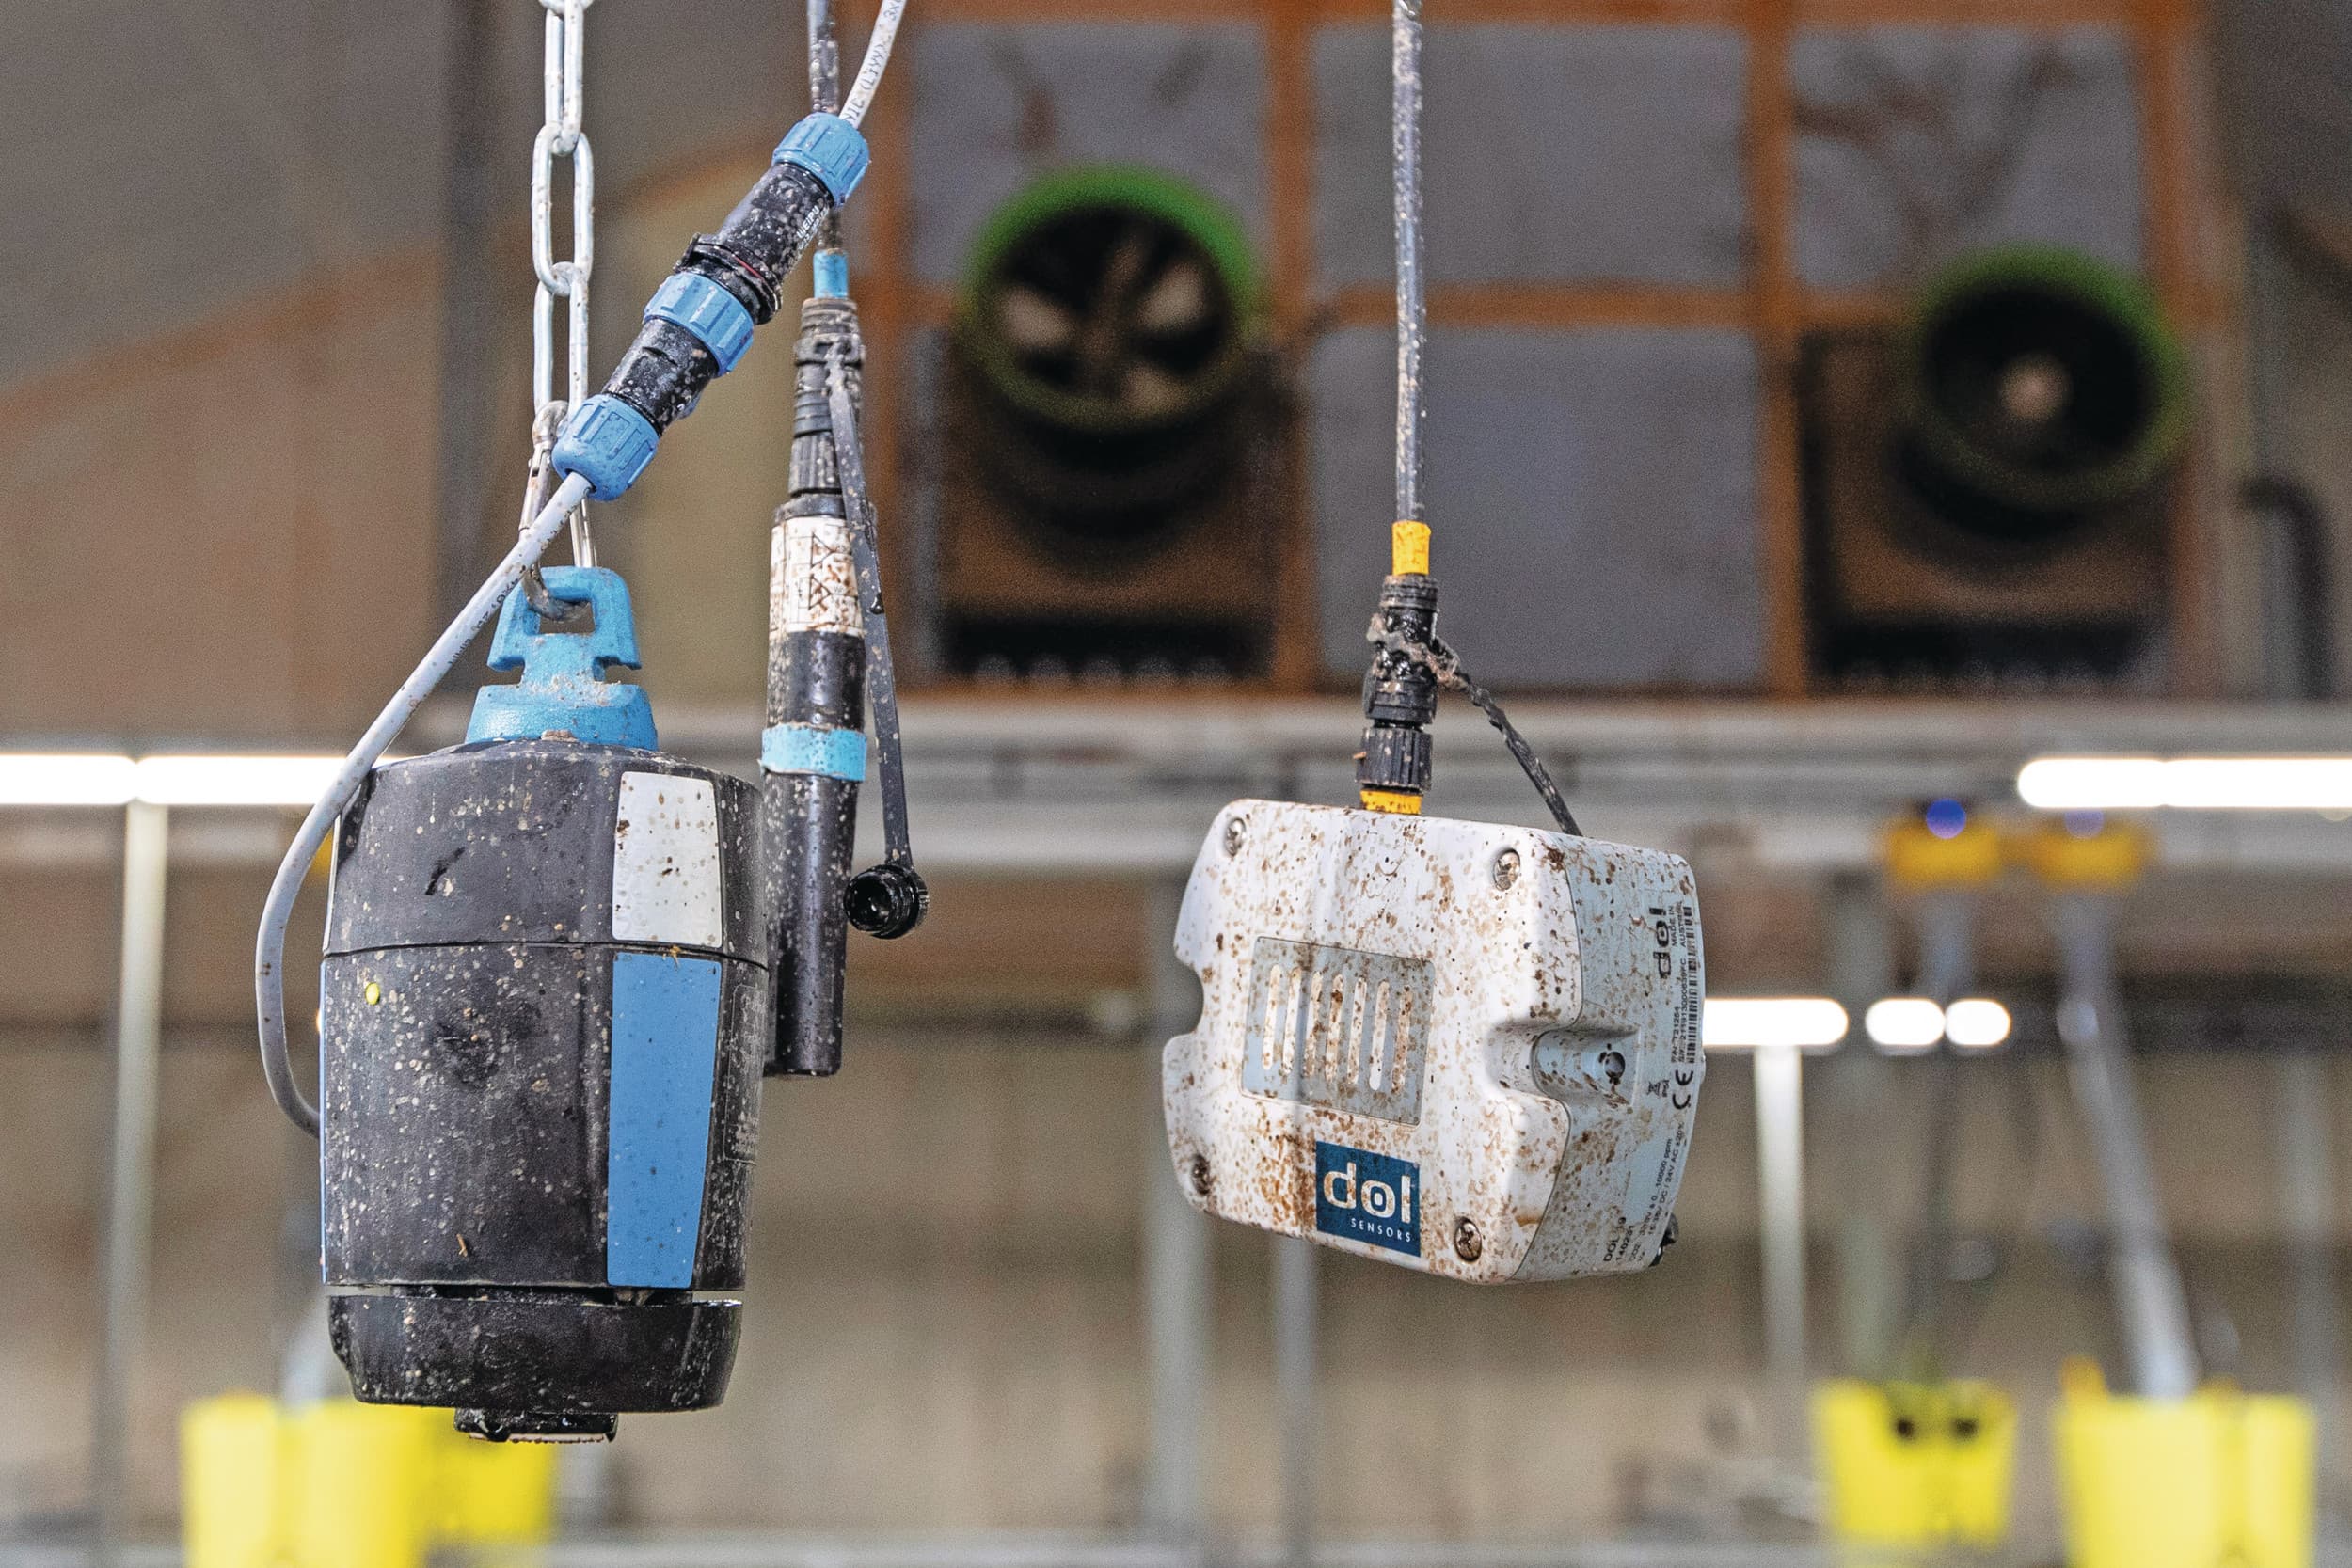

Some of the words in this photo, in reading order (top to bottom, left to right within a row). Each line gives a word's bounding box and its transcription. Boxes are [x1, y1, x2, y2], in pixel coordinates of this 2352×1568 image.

[796, 204, 820, 239] WEIPU
[1668, 905, 1675, 916] IN
[1649, 907, 1671, 979] dol
[1669, 918, 1678, 947] MADE
[1672, 1069, 1694, 1110] CE
[1664, 1138, 1673, 1158] ppm
[1659, 1190, 1668, 1204] DC
[1665, 1164, 1675, 1183] 24V
[1671, 1148, 1678, 1163] AC
[1323, 1161, 1411, 1225] dol
[1350, 1217, 1411, 1243] SENSORS
[1603, 1235, 1619, 1262] DOL
